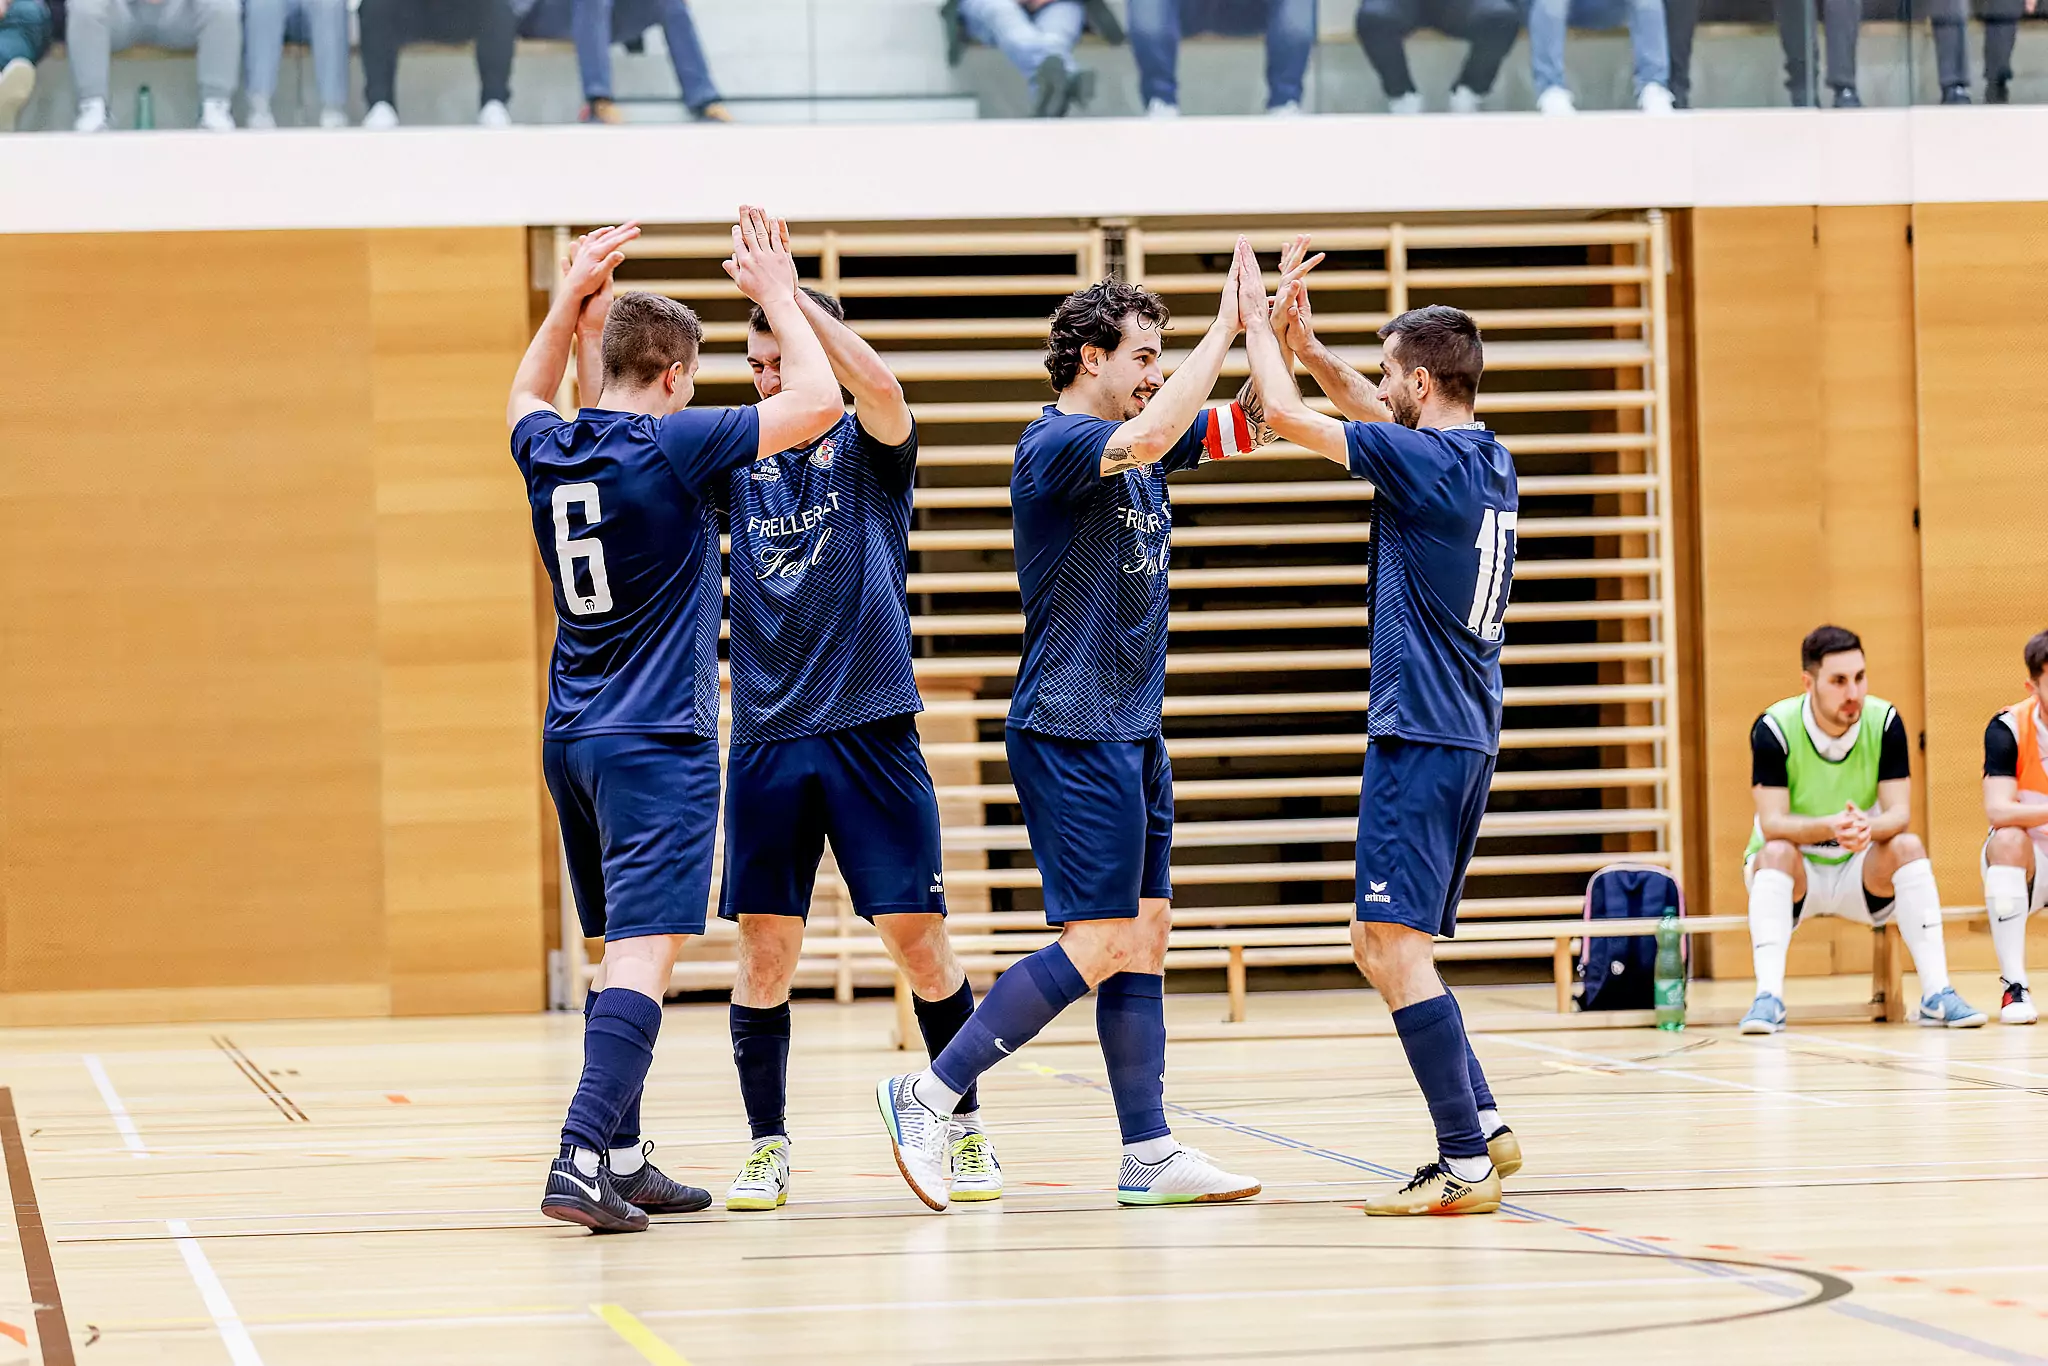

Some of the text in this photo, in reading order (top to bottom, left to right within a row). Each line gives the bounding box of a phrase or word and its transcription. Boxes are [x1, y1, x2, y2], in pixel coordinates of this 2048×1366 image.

[552, 481, 613, 616] 6
[1467, 508, 1518, 640] 10
[1364, 892, 1391, 904] erima
[1440, 1186, 1473, 1208] adidas
